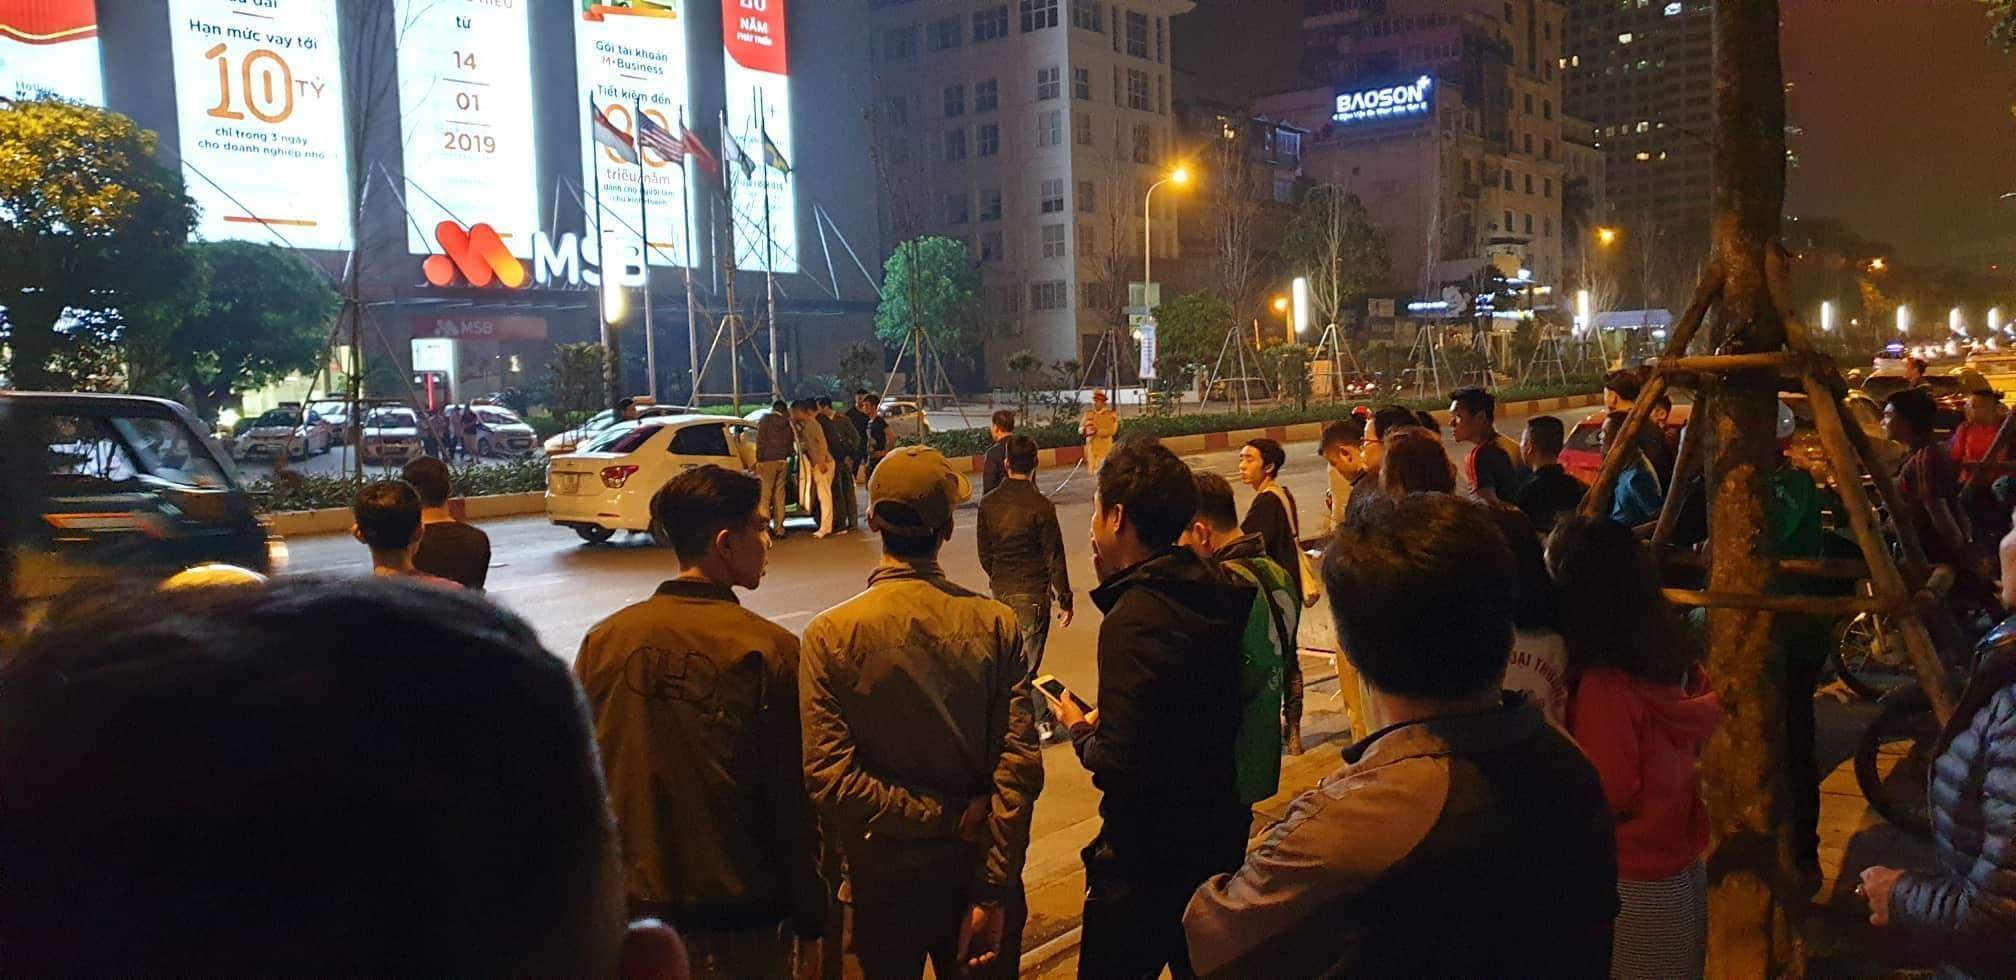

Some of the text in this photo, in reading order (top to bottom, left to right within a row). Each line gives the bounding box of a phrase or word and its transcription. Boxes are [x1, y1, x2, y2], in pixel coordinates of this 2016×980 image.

[189, 19, 318, 50] Hạn mức vay tới
[740, 16, 768, 34] NĂM
[452, 50, 478, 70] 14
[204, 42, 294, 124] 10
[598, 84, 618, 98] Tiết
[456, 92, 480, 111] 01
[235, 129, 267, 143] trong
[270, 132, 278, 142] 3
[444, 131, 497, 154] 2019
[198, 139, 220, 150] cho
[223, 142, 260, 153] doanh
[533, 231, 648, 287] MSB
[461, 320, 494, 335] MSB
